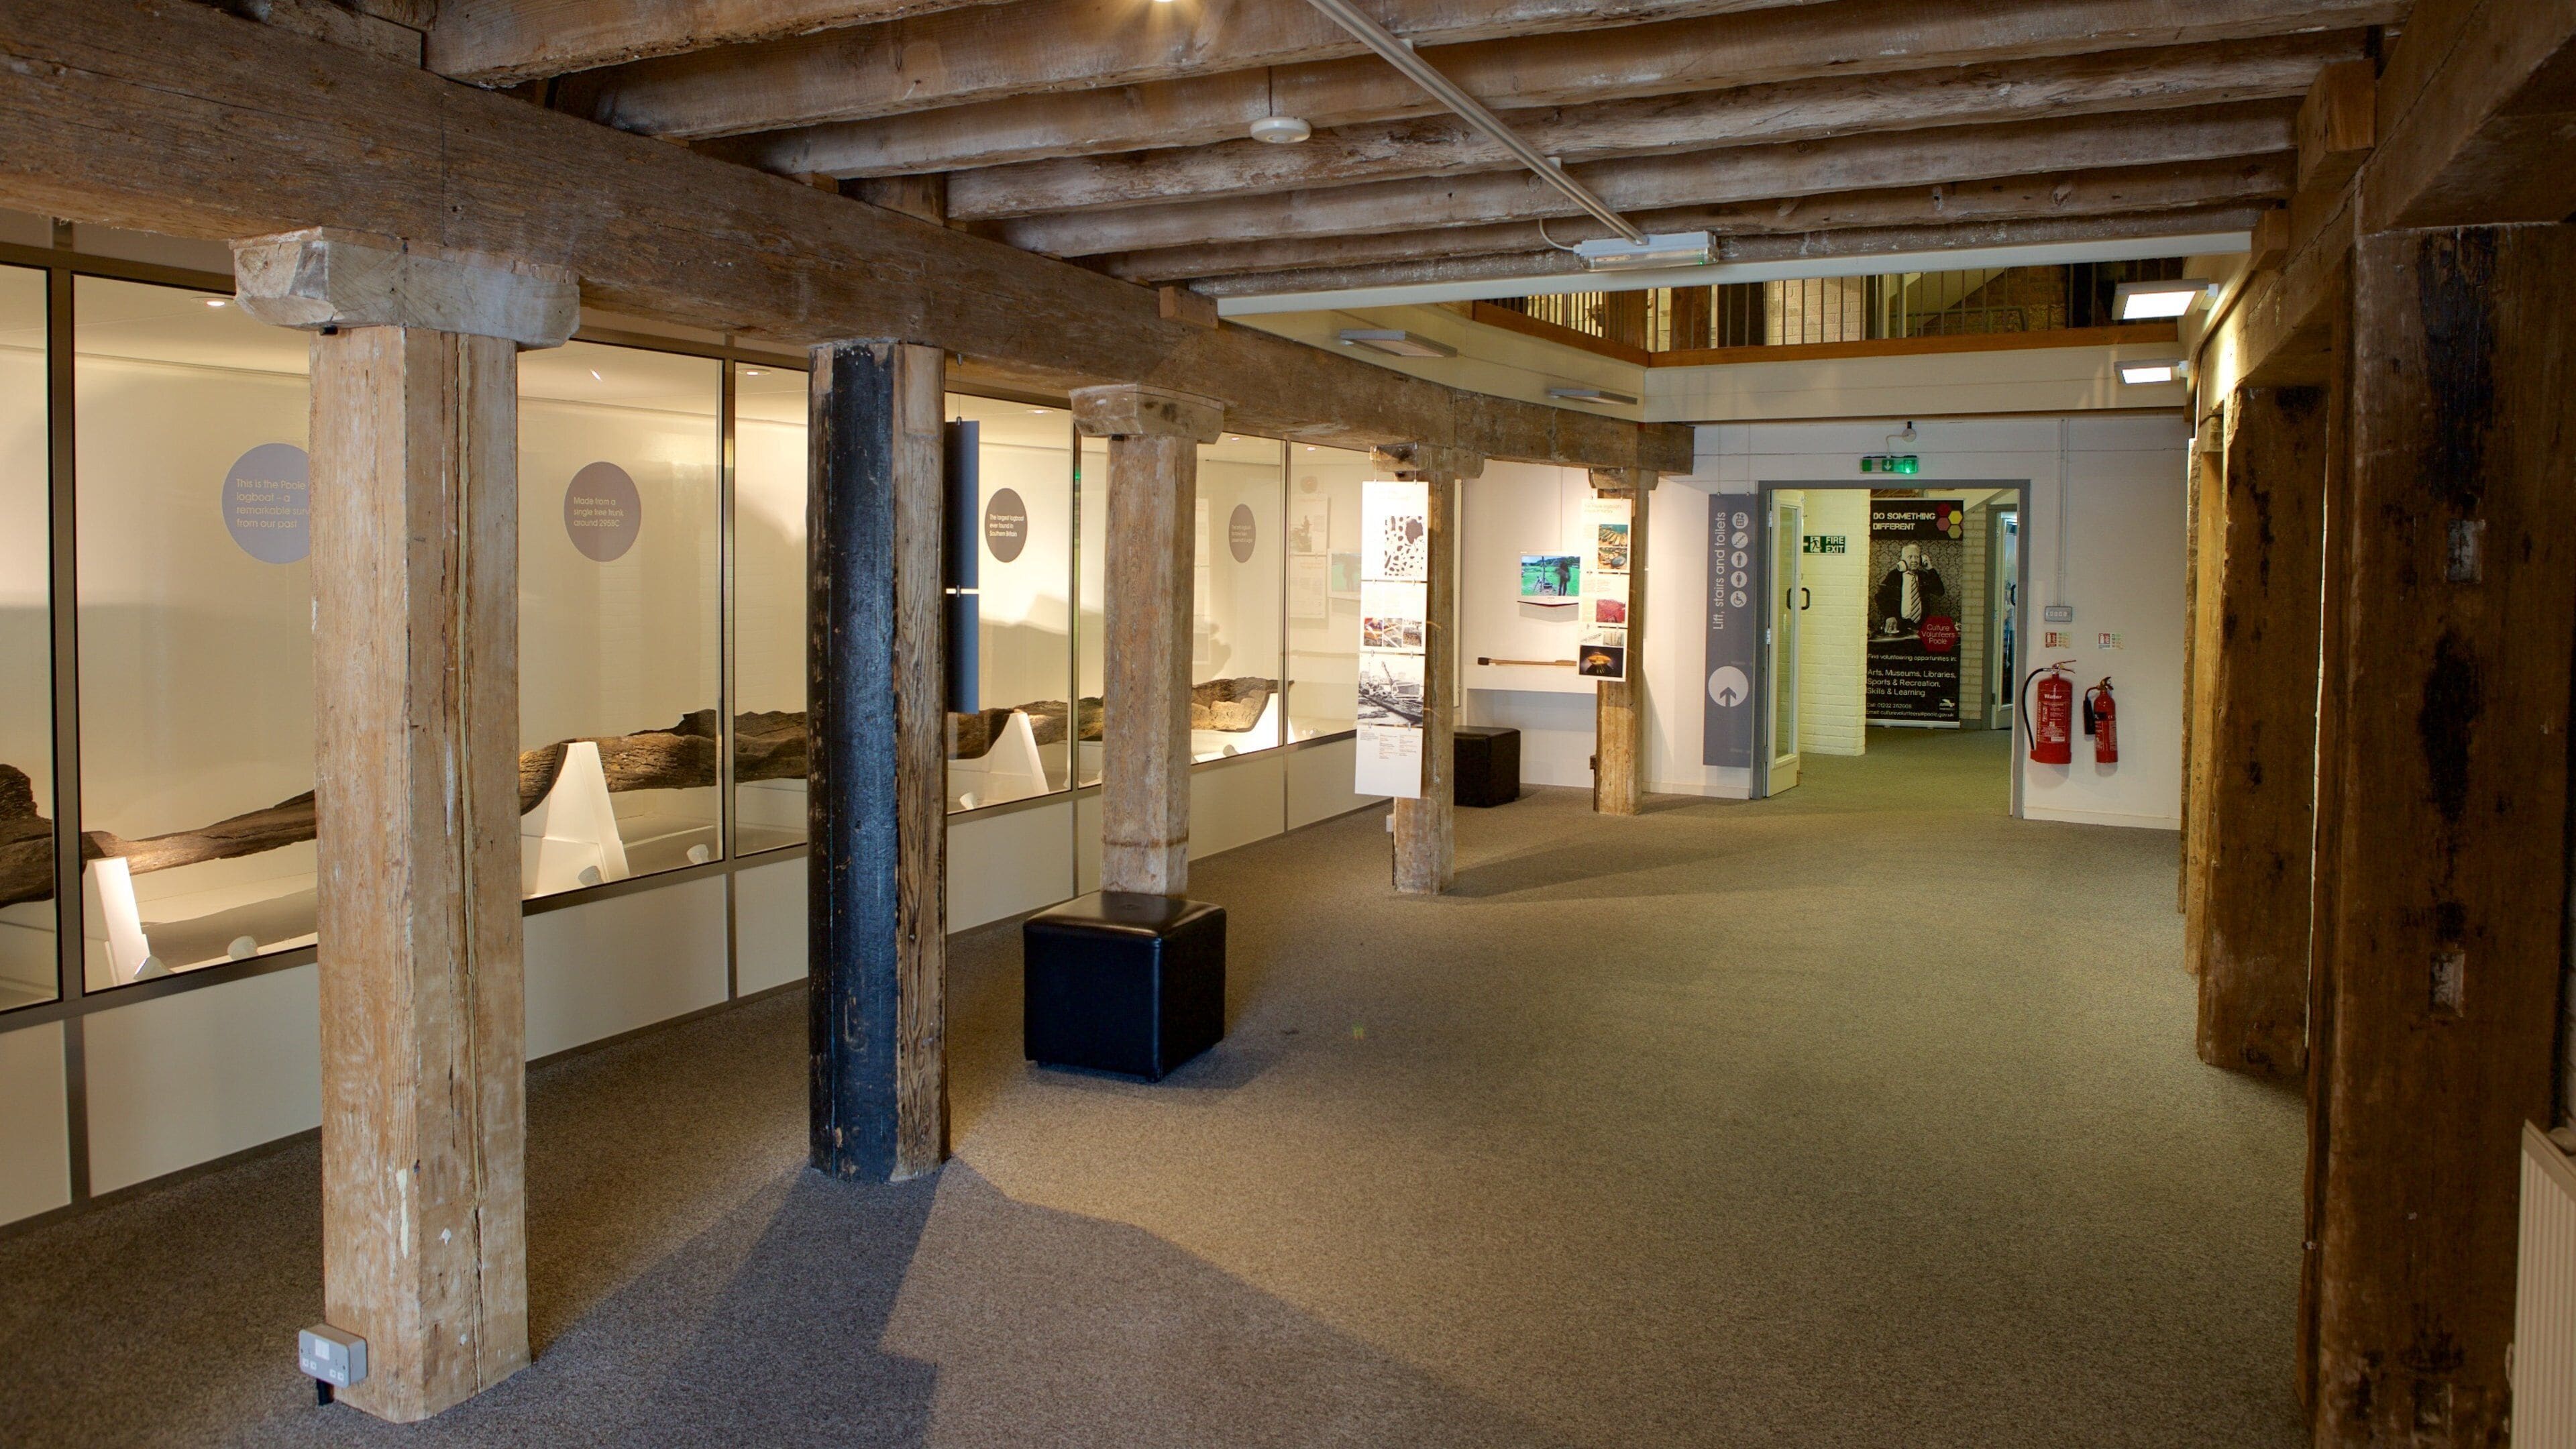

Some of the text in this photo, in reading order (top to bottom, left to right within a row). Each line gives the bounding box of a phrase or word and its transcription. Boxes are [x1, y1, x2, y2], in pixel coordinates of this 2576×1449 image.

[236, 478, 306, 490] This is the Poole
[236, 492, 274, 503] logboat
[236, 506, 290, 515] remarkable
[574, 508, 593, 517] single
[608, 508, 624, 517] trunk
[1886, 512, 1936, 520] SOMETHING
[236, 519, 258, 528] from
[278, 521, 297, 529] past
[1825, 536, 1844, 544] FIRE
[1825, 545, 1843, 553] EXIT
[1713, 512, 1726, 629] Lift, stairs and toilets
[1923, 670, 1956, 678] Libraries,
[1867, 678, 1890, 686] Sports
[1899, 679, 1941, 687] Recreation,
[1867, 687, 1885, 695] Skills
[1894, 688, 1926, 698] Learning
